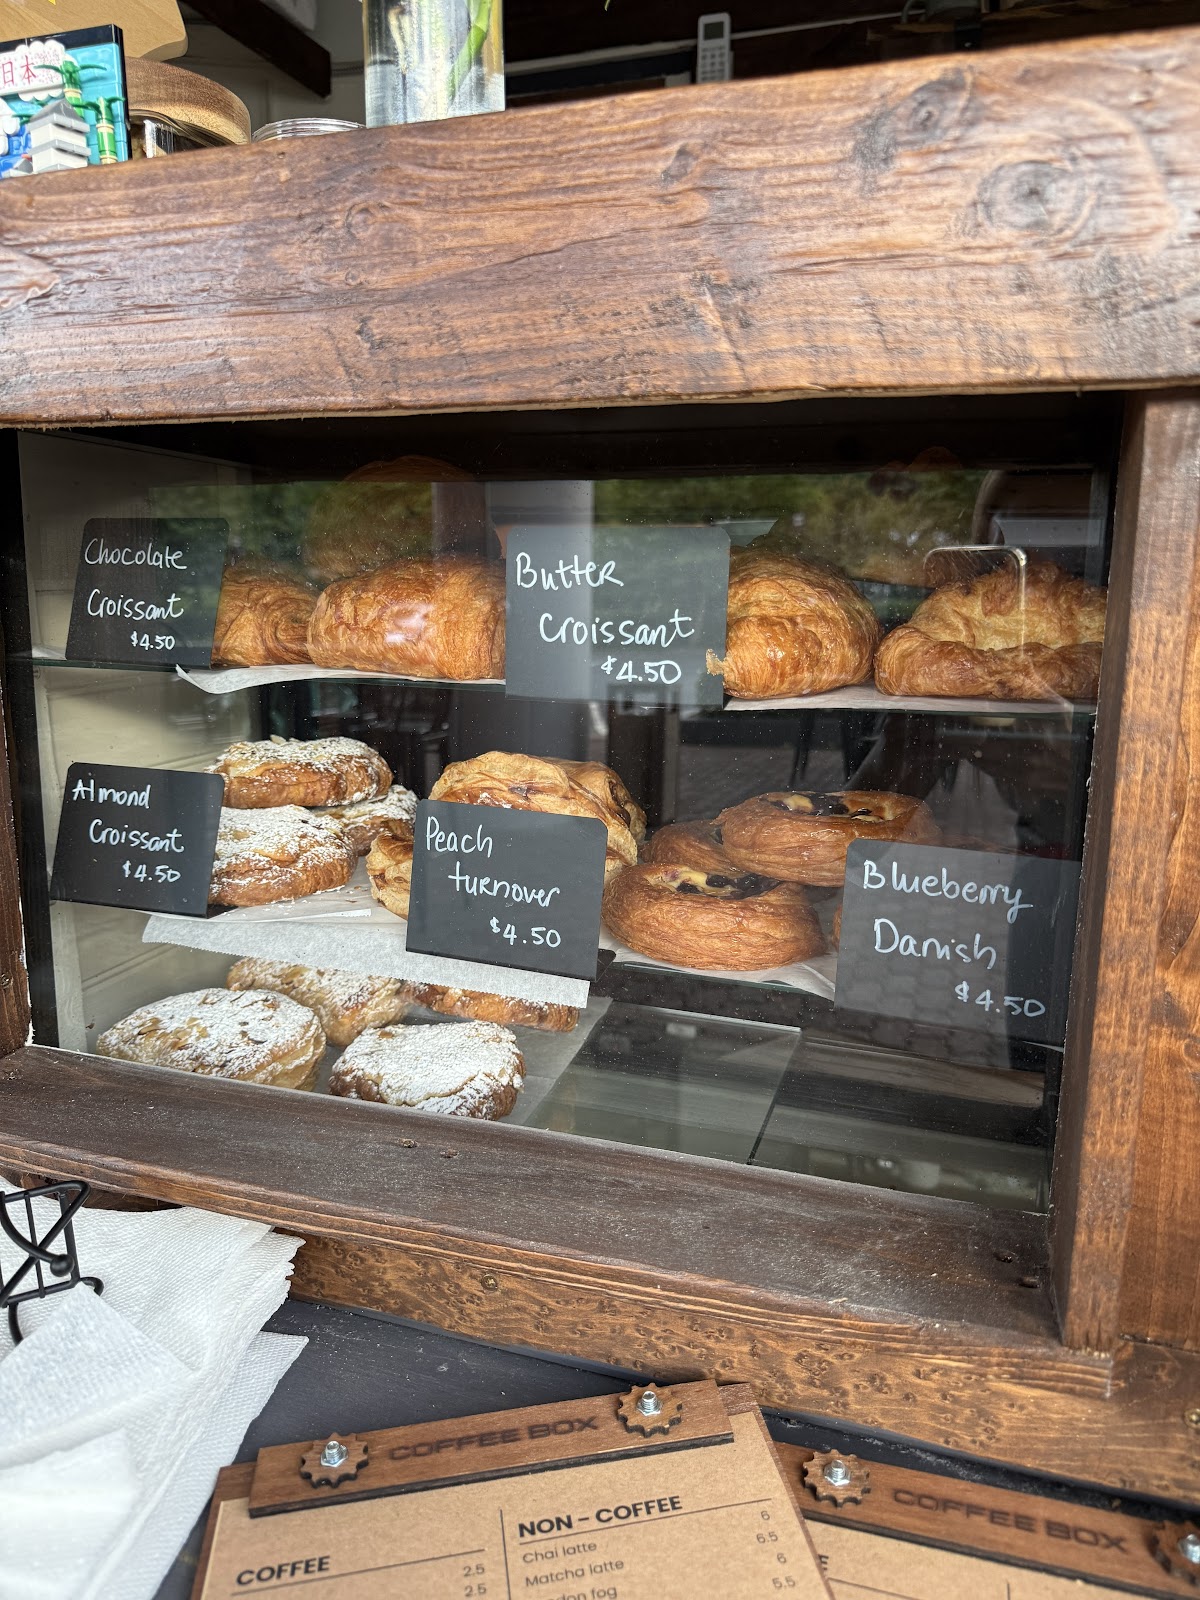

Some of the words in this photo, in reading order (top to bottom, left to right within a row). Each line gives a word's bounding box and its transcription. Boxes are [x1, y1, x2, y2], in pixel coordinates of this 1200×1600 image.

[2, 54, 37, 86] 日本
[84, 538, 188, 570] Chocolate
[87, 588, 184, 620] Croissant
[130, 630, 176, 651] $4.50
[539, 609, 695, 648] Croissant
[600, 655, 682, 684] $4.50
[72, 779, 151, 809] Almond
[89, 818, 184, 853] Croissant
[426, 816, 493, 857] Peach
[122, 860, 181, 883] $4.50
[863, 859, 1034, 924] Blueberry
[489, 916, 562, 948] $4.50
[873, 918, 997, 970] Danish
[954, 980, 1046, 1018] $4.50
[389, 1428, 522, 1461] COFFEE
[527, 1416, 599, 1440] BOX
[518, 1514, 573, 1538] NON
[595, 1495, 683, 1524] COFFEE
[760, 1510, 771, 1521] 6
[893, 1488, 1038, 1534] COFFEE
[1044, 1520, 1129, 1555] BOX
[522, 1547, 559, 1564] Chai
[562, 1542, 598, 1557] latte
[756, 1531, 779, 1544] 6.5
[236, 1555, 331, 1586] COFFEE
[463, 1563, 486, 1578] 2.5
[525, 1568, 585, 1587] Matcha
[588, 1560, 625, 1576] latte
[776, 1552, 787, 1564] 6
[464, 1583, 488, 1598] 2.5
[591, 1585, 618, 1600] fog
